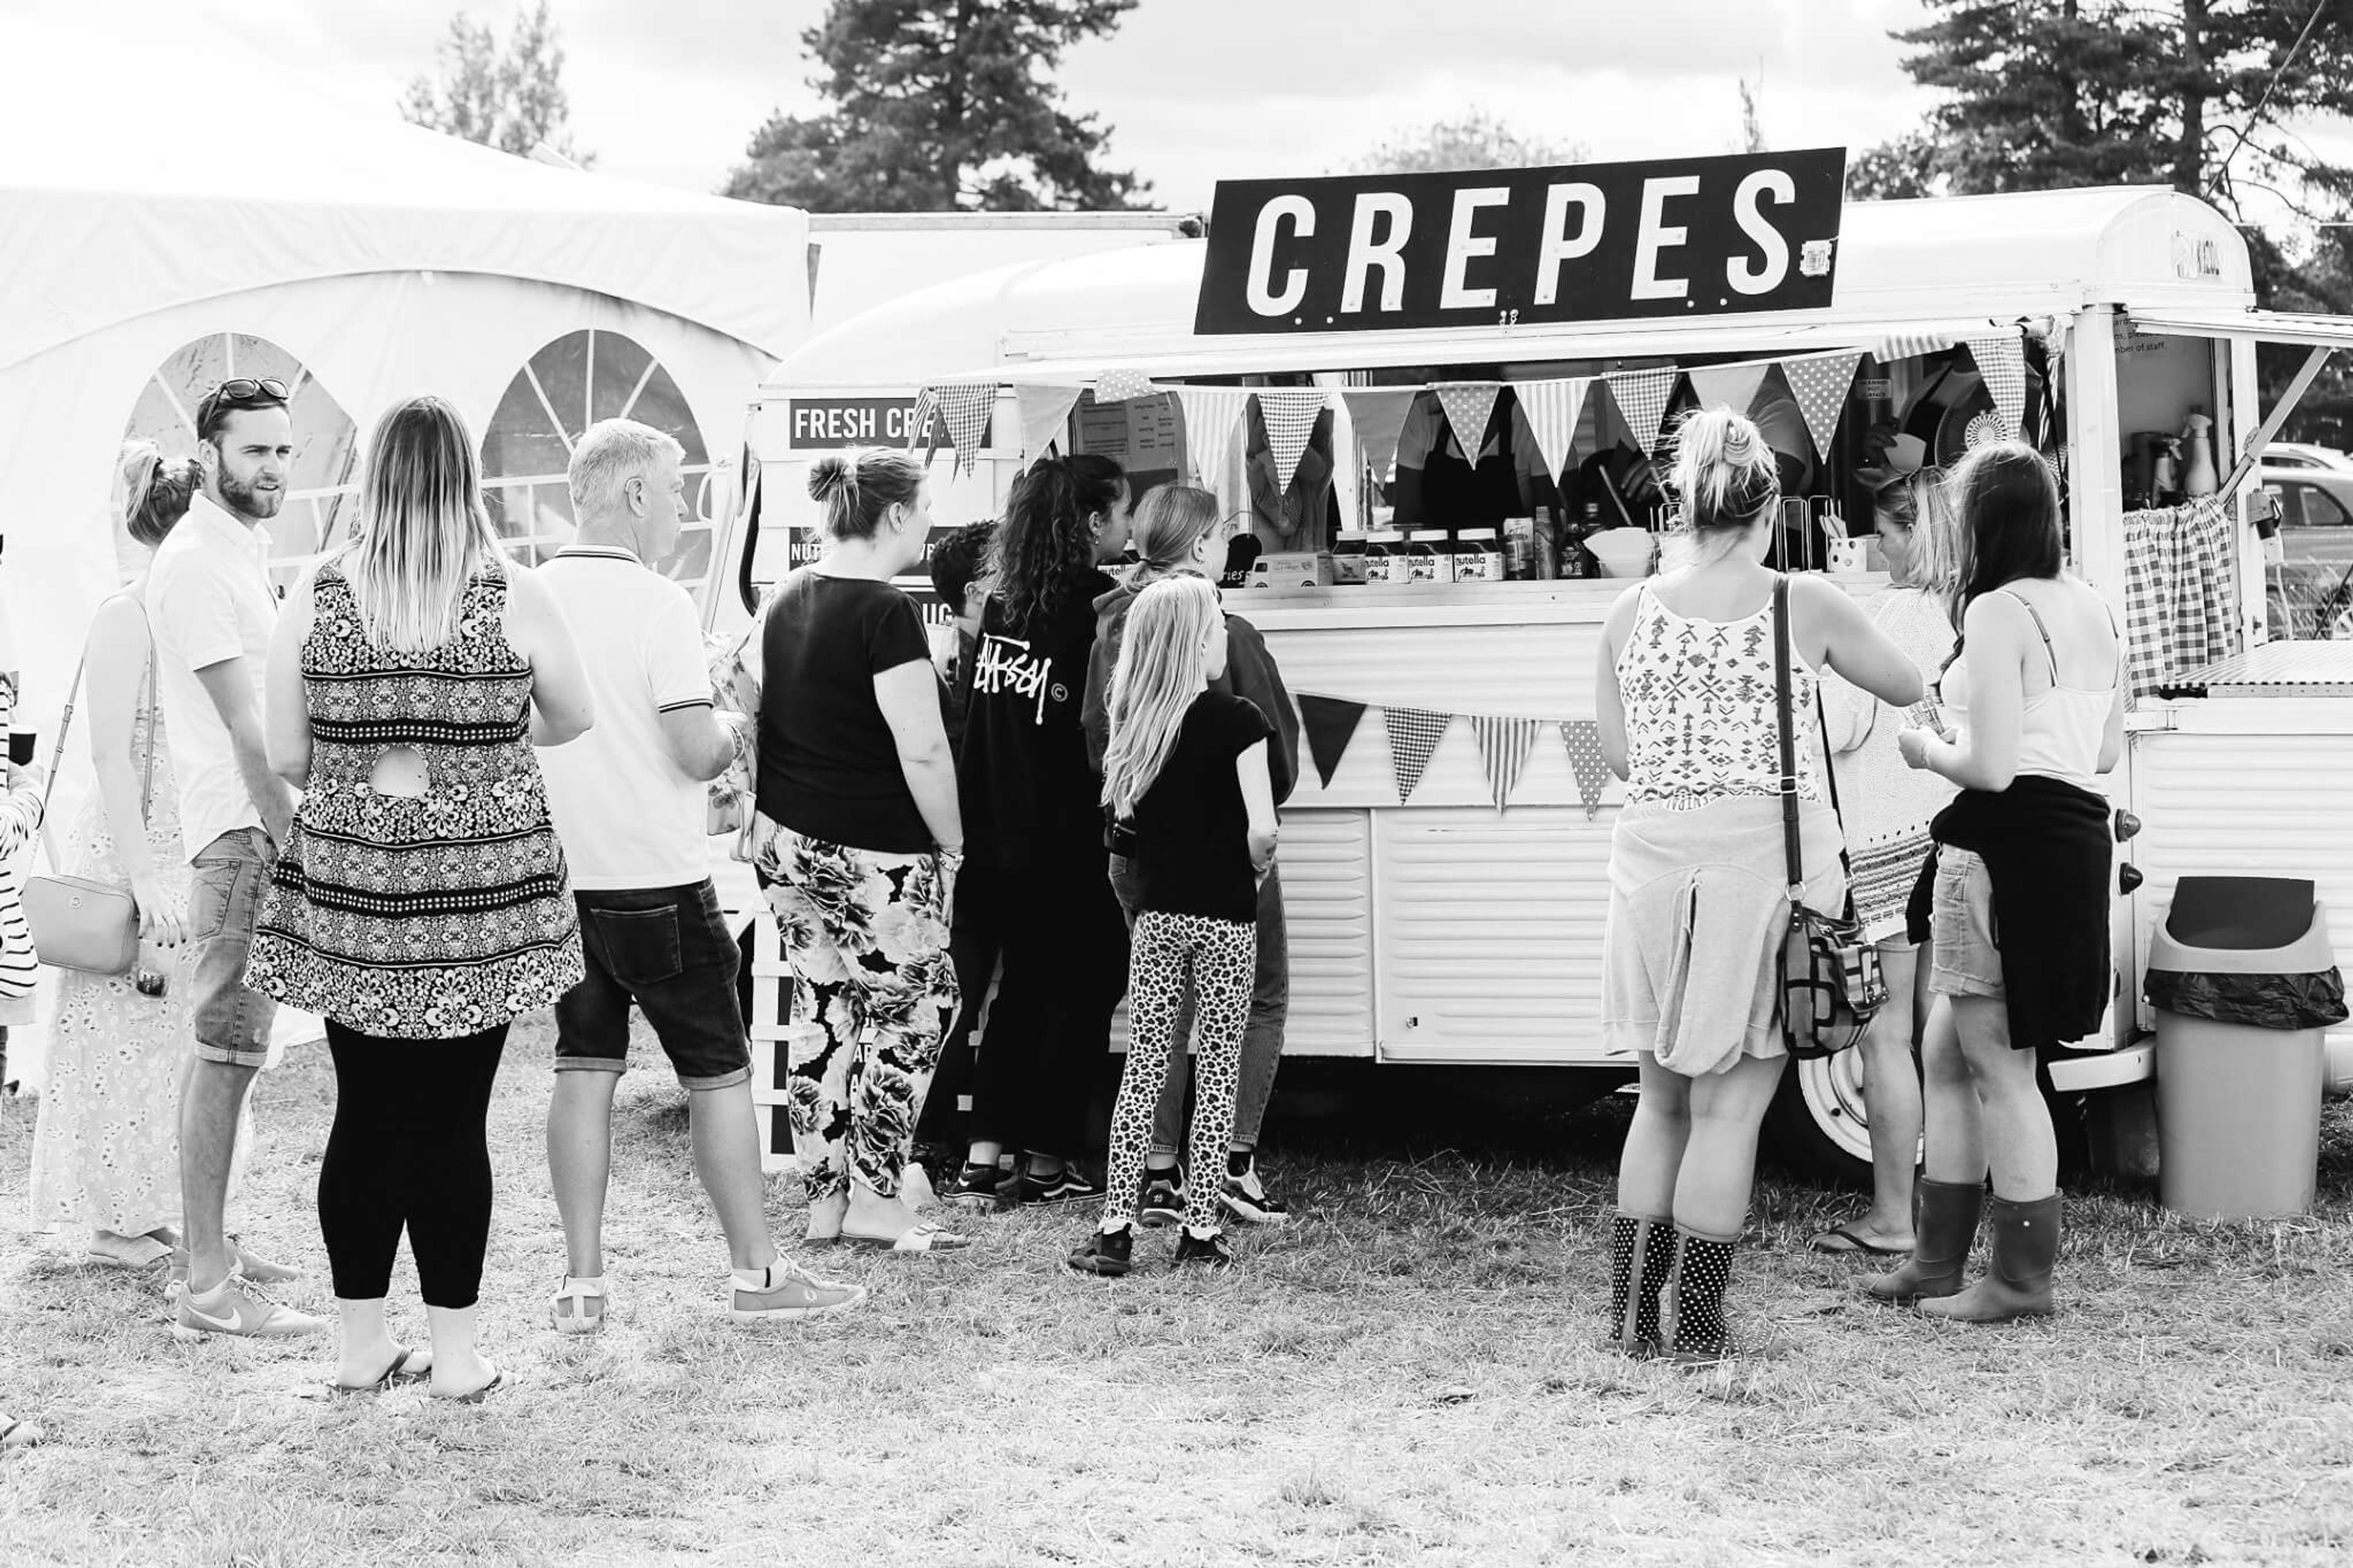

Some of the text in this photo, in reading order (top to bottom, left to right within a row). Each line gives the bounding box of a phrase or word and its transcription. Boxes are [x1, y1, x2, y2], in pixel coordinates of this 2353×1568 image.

[1246, 169, 1796, 317] CREPES
[794, 408, 876, 439] FRESH
[790, 543, 822, 561] NUT
[1455, 553, 1486, 566] nutella
